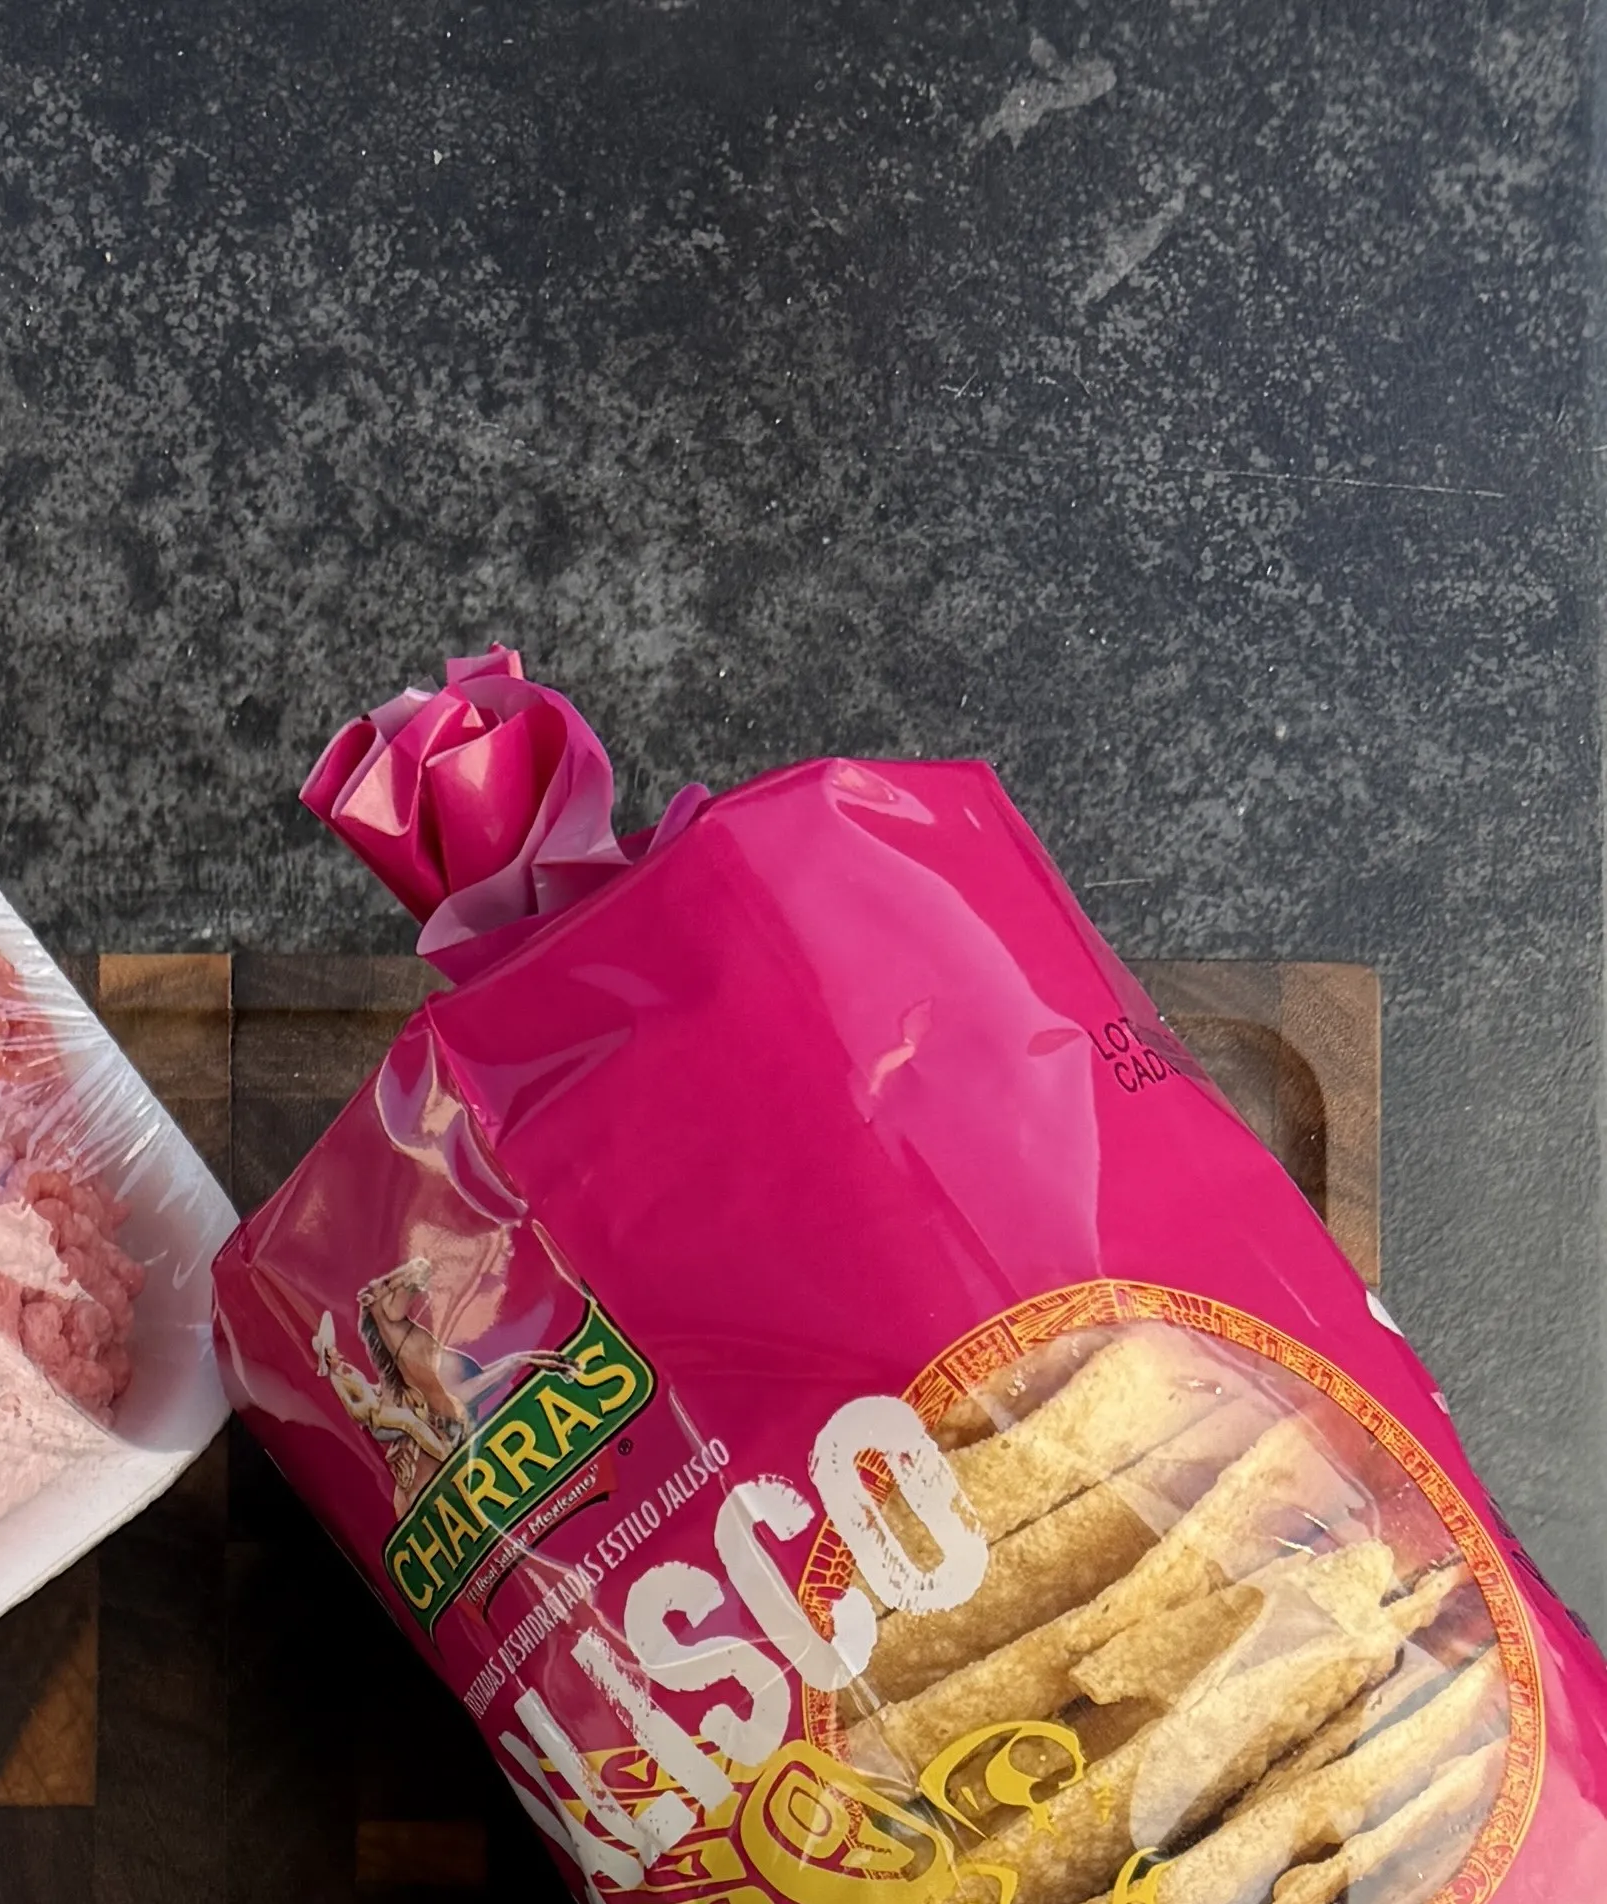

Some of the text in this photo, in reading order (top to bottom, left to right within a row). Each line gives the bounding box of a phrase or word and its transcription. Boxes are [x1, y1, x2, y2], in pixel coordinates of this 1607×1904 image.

[393, 1340, 634, 1611] CHARRAS
[462, 1435, 734, 1719] TOSTADAS DESHIDRATADAS ESTILO JALISCO
